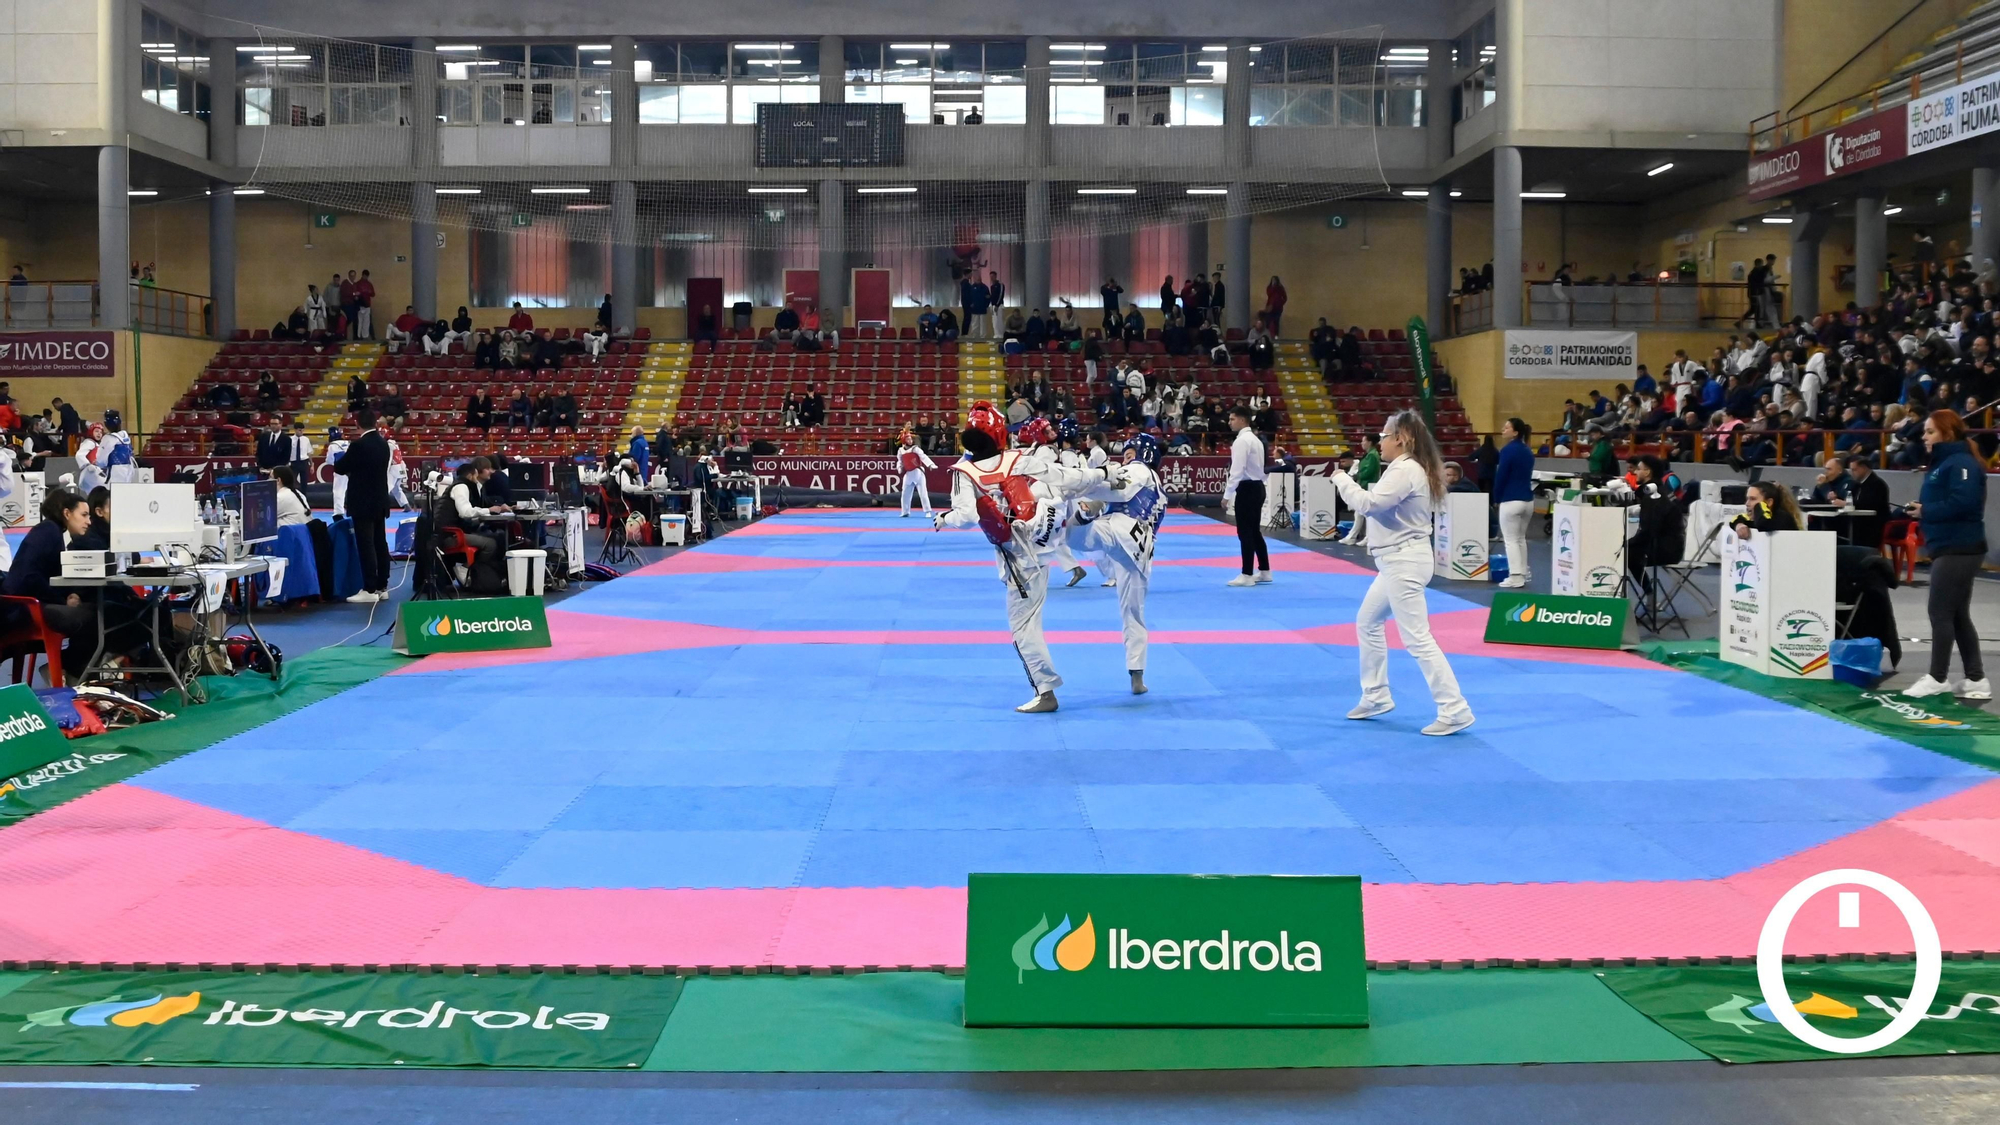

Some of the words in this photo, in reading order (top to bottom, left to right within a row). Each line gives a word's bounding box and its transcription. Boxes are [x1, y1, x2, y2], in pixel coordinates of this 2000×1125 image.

[1760, 150, 1800, 181] IMDECO
[321, 215, 329, 226] K
[518, 214, 526, 225] L
[770, 211, 780, 222] M
[15, 341, 110, 360] IMDECO
[1560, 345, 1624, 355] PATRIMONIO
[1509, 356, 1553, 366] CÓRDOBA
[1560, 356, 1632, 366] HUMANIDAD
[780, 460, 843, 471] MUNICIPAL
[1196, 482, 1207, 493] DE
[1035, 506, 1056, 547] Navarra
[1536, 608, 1612, 627] Iberdrola
[454, 616, 532, 635] Iberdrola
[0, 711, 46, 742] erdrola
[1109, 928, 1322, 972] Iberdrola
[203, 999, 610, 1031] Iberdrola
